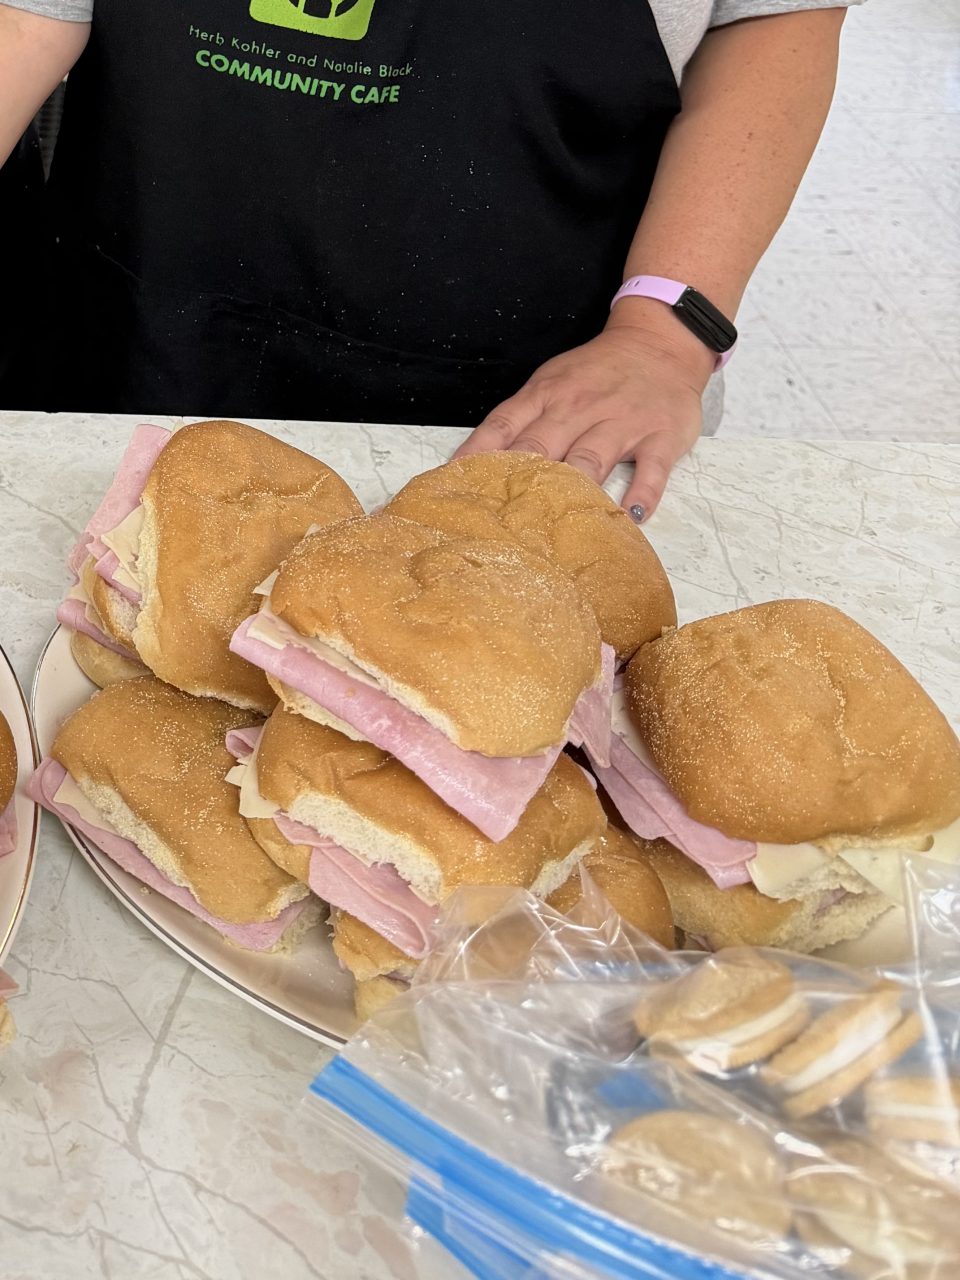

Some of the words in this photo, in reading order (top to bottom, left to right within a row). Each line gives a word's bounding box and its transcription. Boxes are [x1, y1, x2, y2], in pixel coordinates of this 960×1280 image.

[189, 24, 225, 46] Herb
[231, 37, 281, 59] Kohler
[287, 53, 317, 68] and
[323, 58, 372, 76] Natalie
[379, 63, 413, 78] Black
[195, 49, 346, 101] COMMUNITY
[350, 84, 401, 104] CAFE
